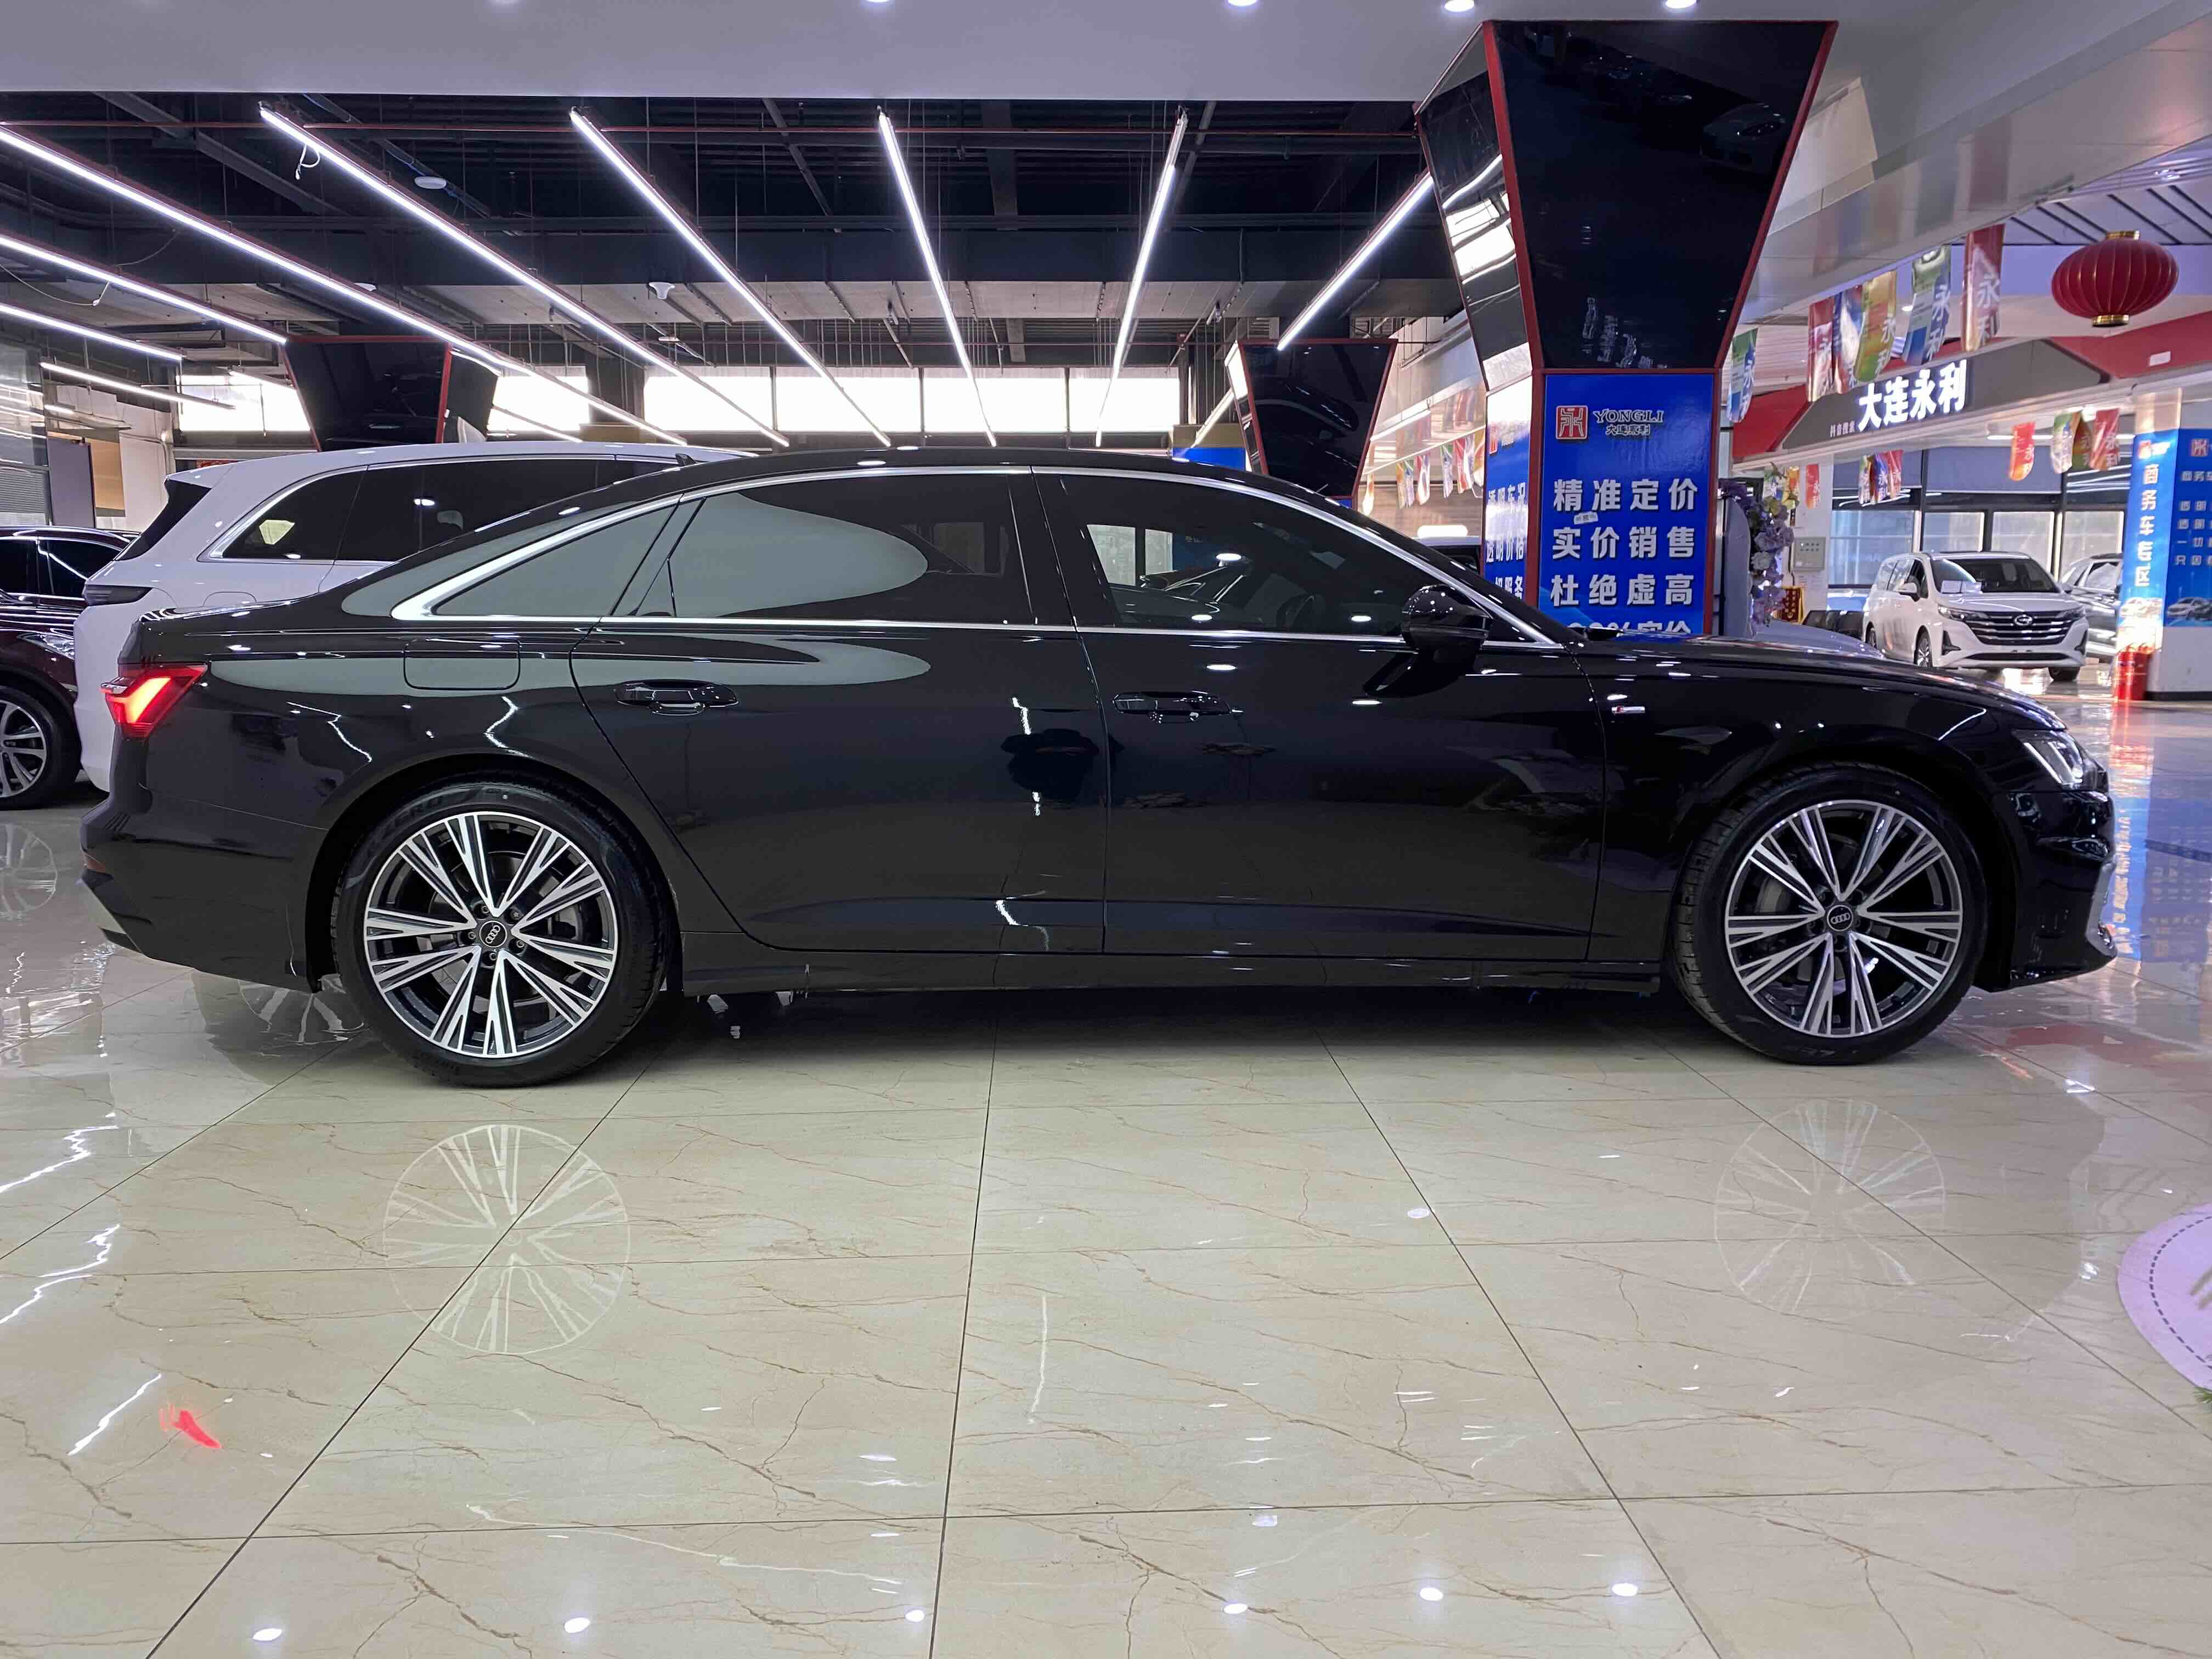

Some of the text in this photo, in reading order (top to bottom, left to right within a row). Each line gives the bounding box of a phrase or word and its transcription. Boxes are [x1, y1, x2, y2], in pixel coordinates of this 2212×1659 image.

[1858, 359, 1967, 432] 大连永利
[1593, 408, 1664, 423] YONGLI
[1554, 478, 1697, 511] 精准定价
[1553, 526, 1695, 559] 实价销售
[1550, 574, 1694, 607] 杜绝虚高
